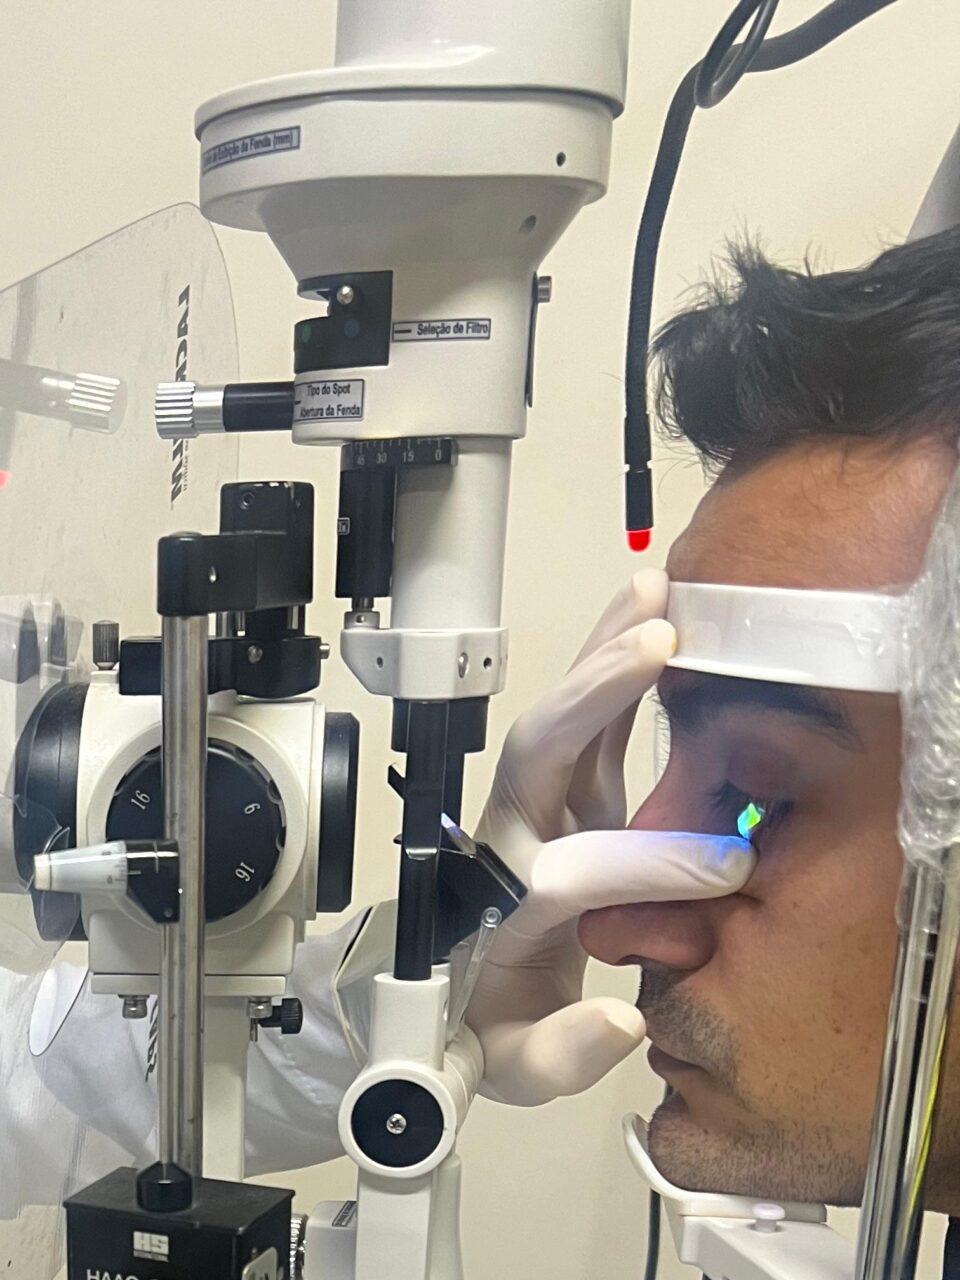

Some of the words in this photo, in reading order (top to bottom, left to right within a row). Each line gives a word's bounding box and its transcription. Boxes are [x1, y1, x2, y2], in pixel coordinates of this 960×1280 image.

[417, 323, 451, 338] Seleção
[453, 322, 464, 334] de
[466, 321, 488, 334] Filtro
[307, 384, 320, 398] Tipo
[322, 383, 331, 395] do
[333, 383, 351, 397] Spot
[326, 404, 335, 416] da
[337, 404, 360, 416] Fenda
[403, 451, 414, 463] 15
[435, 449, 442, 461] 0
[130, 789, 151, 810] 16
[234, 862, 255, 883] 16
